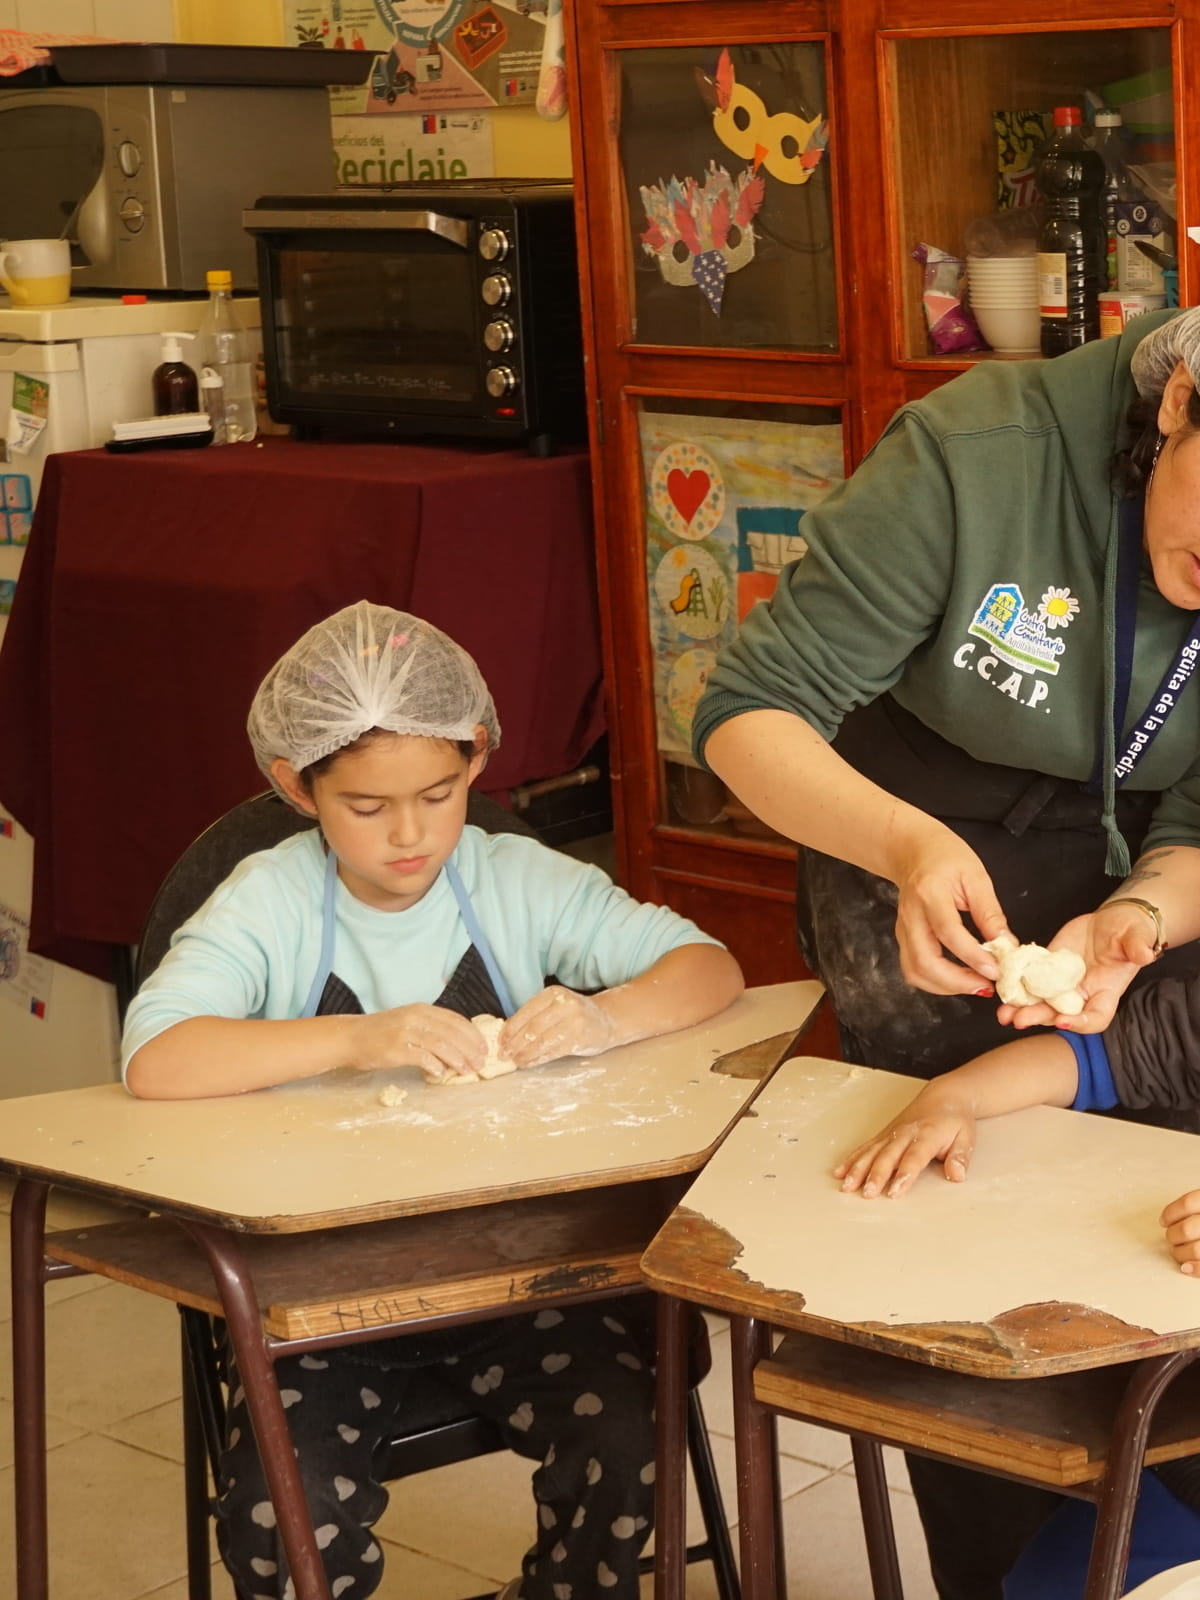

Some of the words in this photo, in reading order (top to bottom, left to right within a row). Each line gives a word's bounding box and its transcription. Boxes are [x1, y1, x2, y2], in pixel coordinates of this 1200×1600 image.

[1013, 624, 1064, 653] Comunitario
[1155, 692, 1174, 714] de
[1144, 714, 1164, 731] la
[1114, 730, 1150, 779] perdiz
[331, 1296, 440, 1331] HOLA
